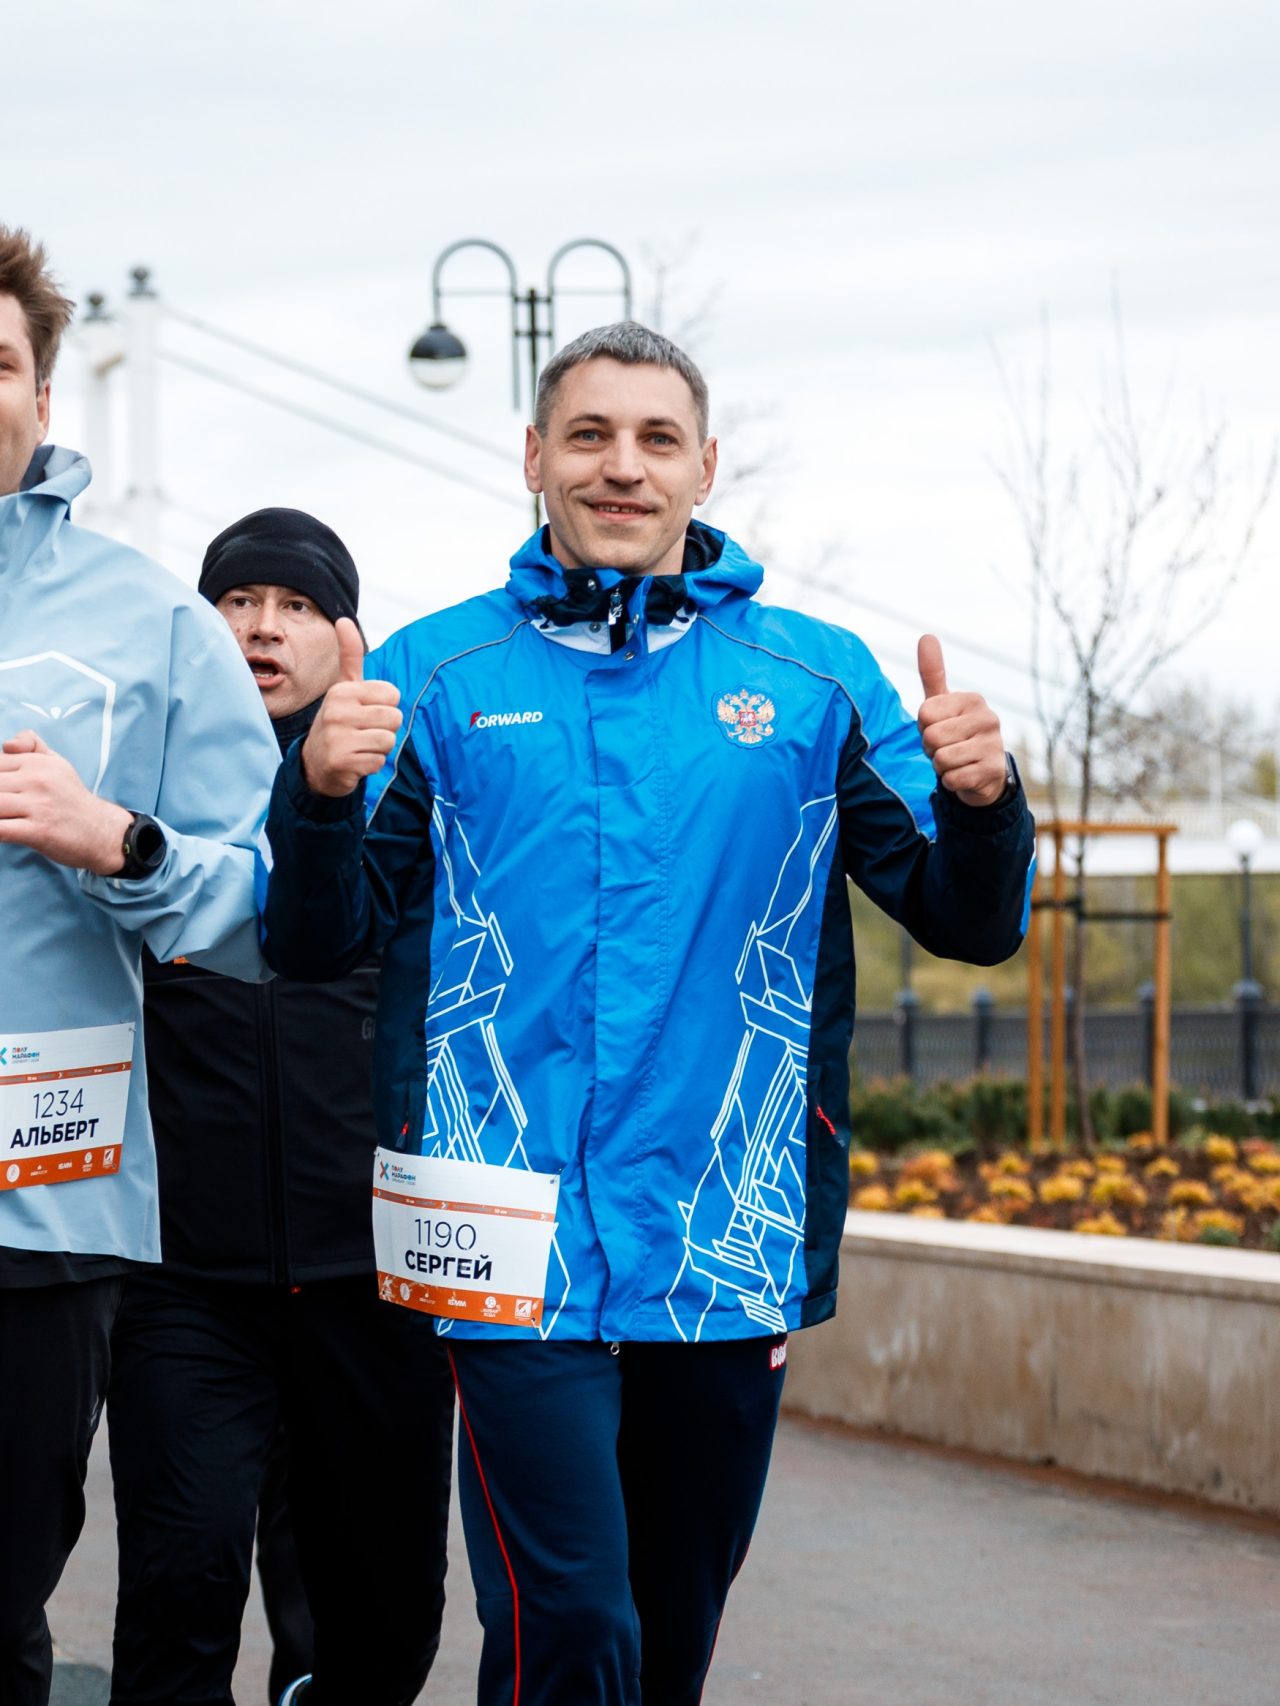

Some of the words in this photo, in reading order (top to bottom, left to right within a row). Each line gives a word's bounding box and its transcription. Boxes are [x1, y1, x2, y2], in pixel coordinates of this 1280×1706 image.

[470, 711, 543, 729] FORWARD
[33, 1087, 84, 1119] 1234
[10, 1118, 100, 1149] АЛЬБЕРТ
[415, 1218, 477, 1250] 1190
[404, 1250, 493, 1281] СЕРГЕЙ
